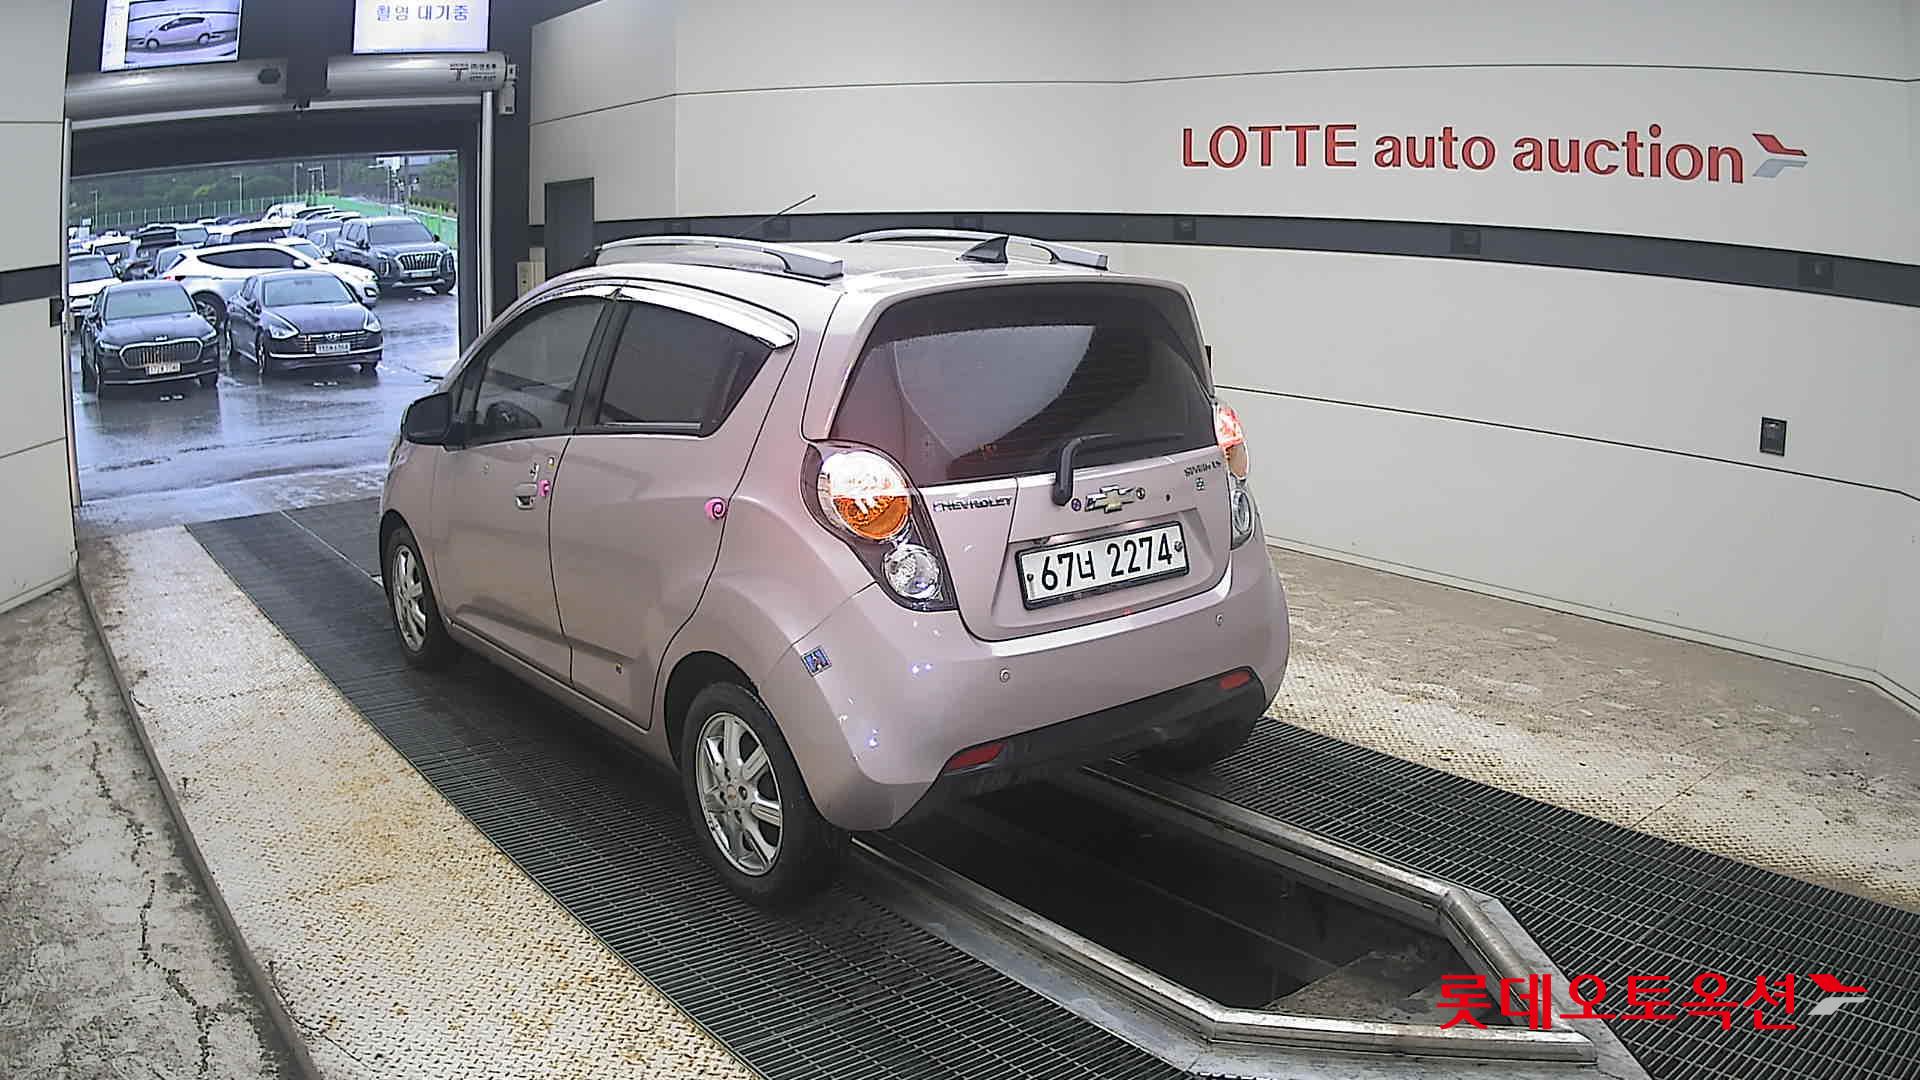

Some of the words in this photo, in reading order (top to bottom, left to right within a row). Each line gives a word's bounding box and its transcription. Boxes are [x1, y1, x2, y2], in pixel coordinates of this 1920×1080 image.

[417, 4, 470, 22] 대기중
[1183, 123, 1358, 169] LOTTE
[1374, 126, 1497, 171] auto
[1513, 123, 1745, 185] auction
[1041, 550, 1096, 591] 67너
[1106, 532, 1173, 578] 2274
